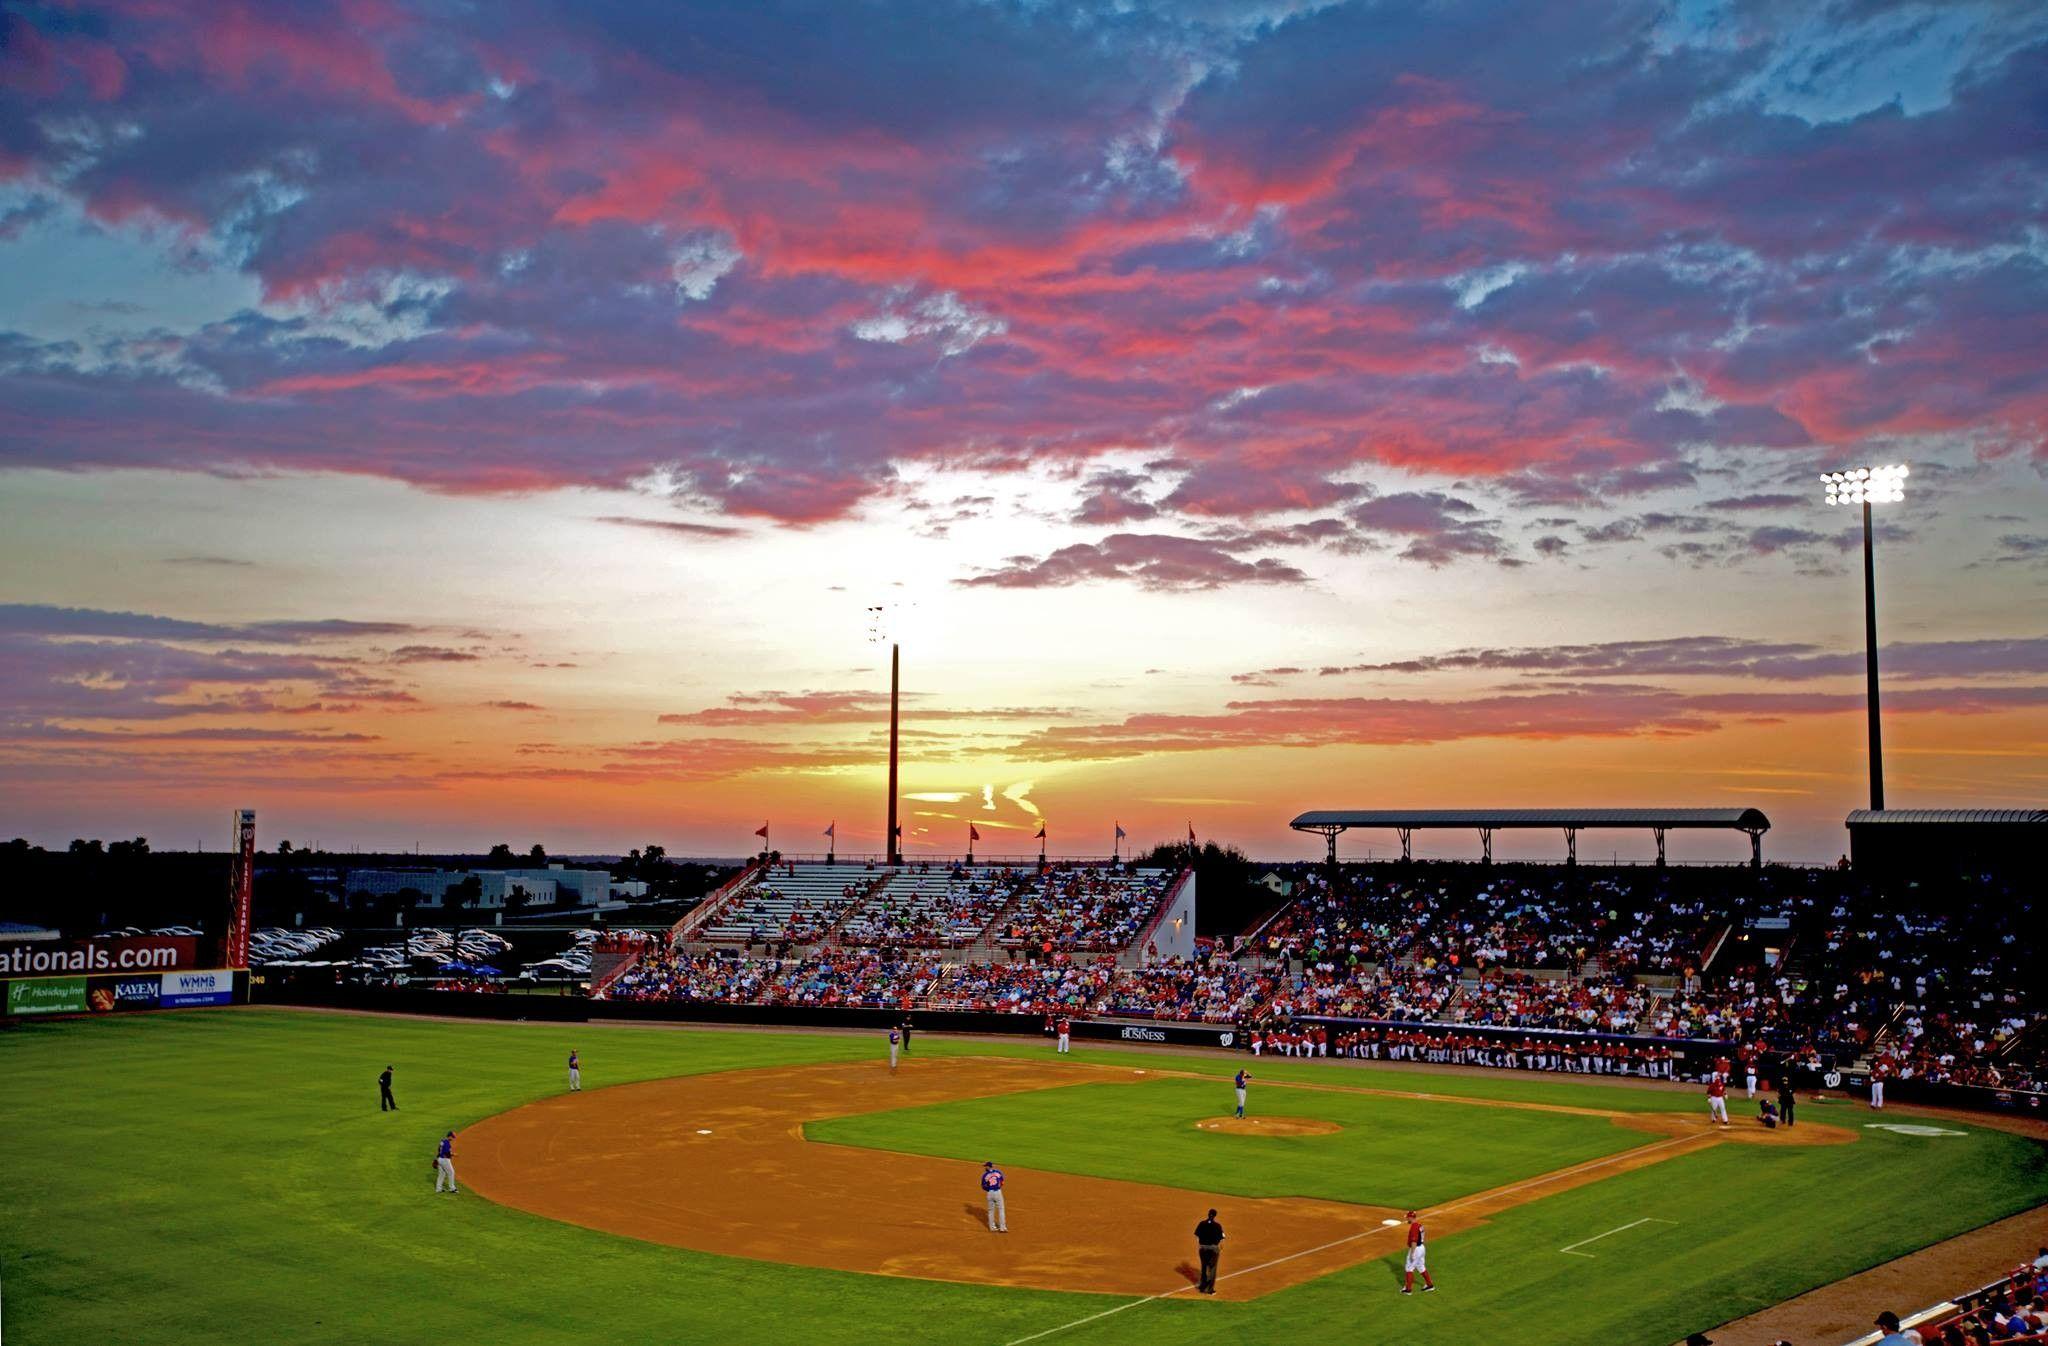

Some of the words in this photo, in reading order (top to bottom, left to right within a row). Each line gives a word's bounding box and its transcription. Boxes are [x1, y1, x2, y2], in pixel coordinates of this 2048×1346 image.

[239, 896, 247, 965] CHAMPIONS
[0, 944, 177, 972] ationals.com
[31, 986, 69, 998] Holiday
[69, 985, 84, 995] Inn
[114, 982, 159, 1000] KAYEM
[1121, 1029, 1166, 1041] BUSINESS
